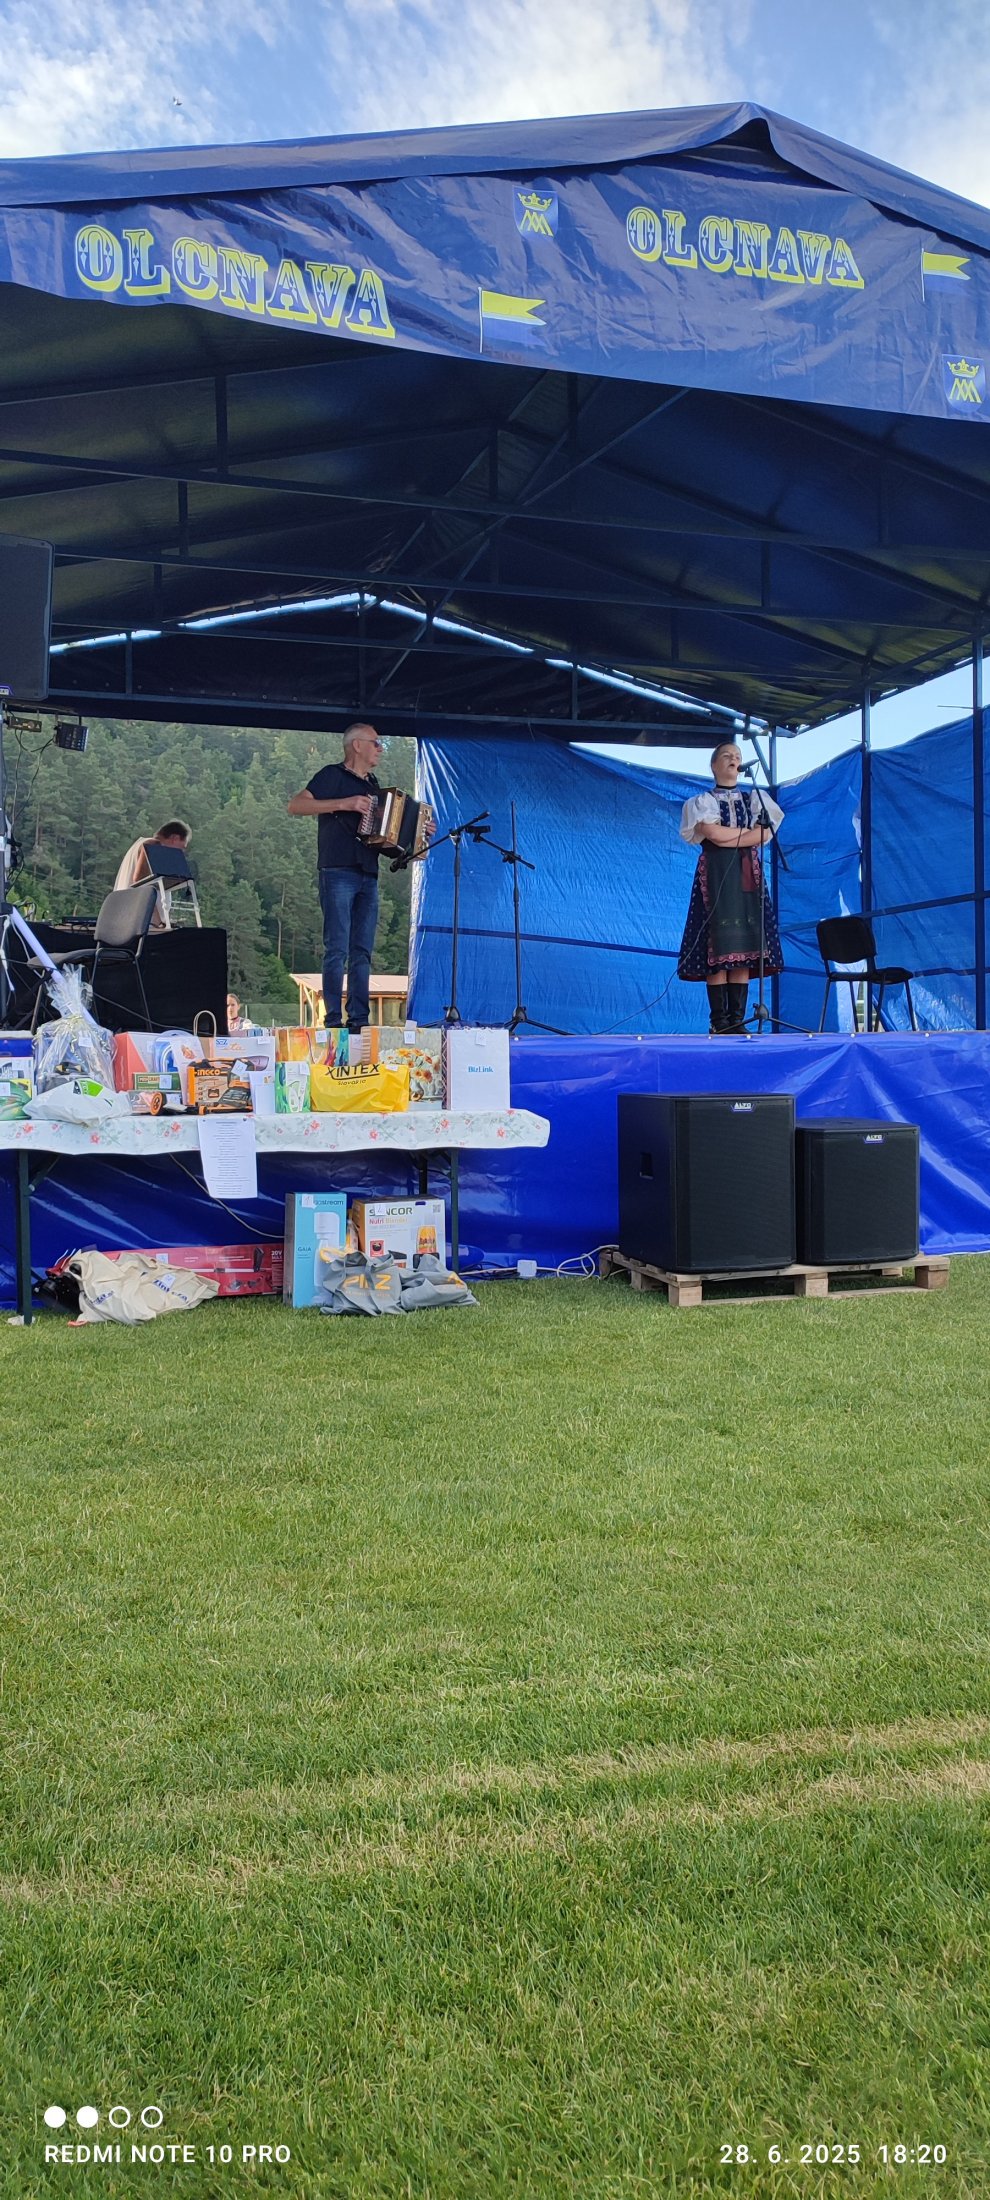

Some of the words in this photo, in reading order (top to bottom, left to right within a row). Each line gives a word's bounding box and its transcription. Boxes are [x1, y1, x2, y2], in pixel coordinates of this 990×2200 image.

[627, 206, 865, 289] OLCNAVA
[75, 224, 396, 339] OLCNAVA
[325, 1063, 380, 1078] XINTEX
[369, 1207, 413, 1216] SNCOR
